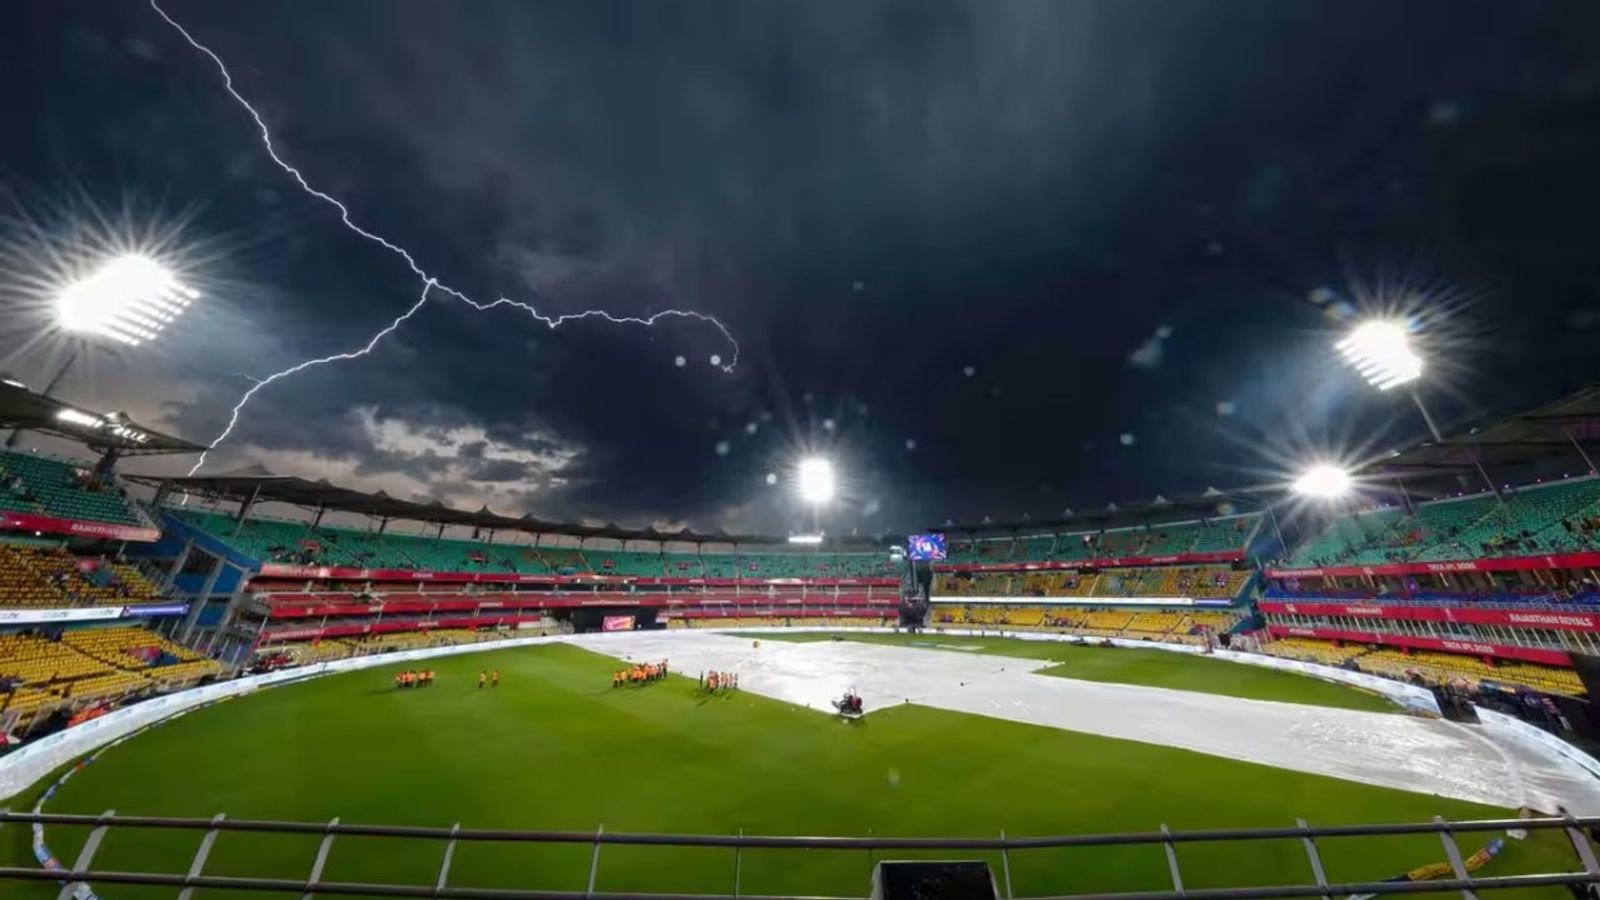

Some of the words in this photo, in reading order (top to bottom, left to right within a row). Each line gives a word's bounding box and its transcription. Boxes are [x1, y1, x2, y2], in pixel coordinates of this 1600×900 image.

[1509, 613, 1560, 624] RAJASTHAN
[1559, 615, 1594, 627] ROYALS
[1442, 641, 1462, 650] TATA
